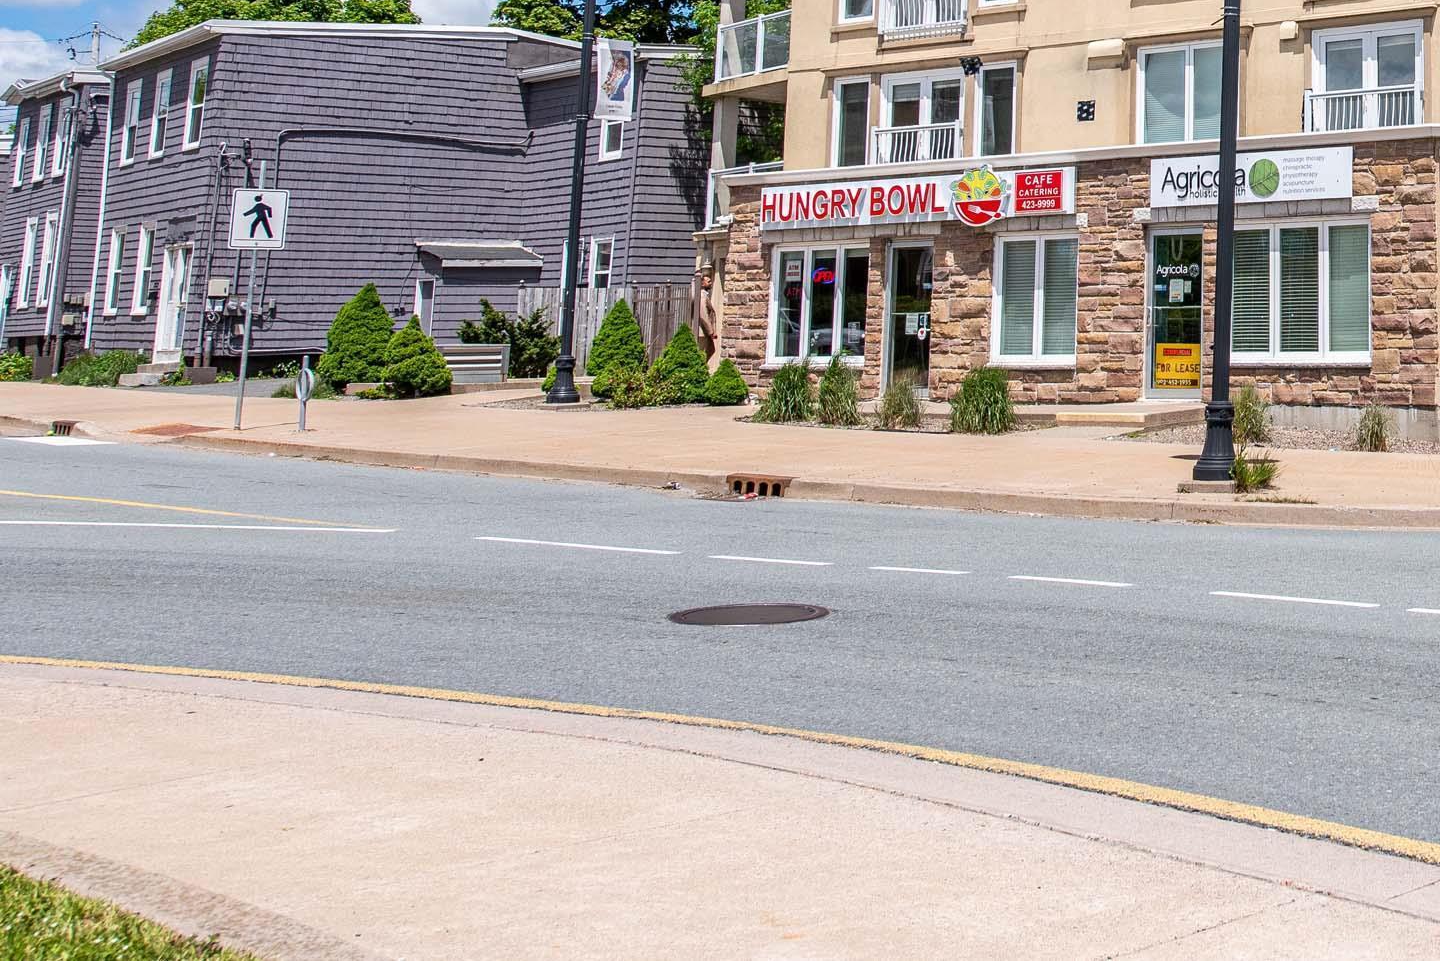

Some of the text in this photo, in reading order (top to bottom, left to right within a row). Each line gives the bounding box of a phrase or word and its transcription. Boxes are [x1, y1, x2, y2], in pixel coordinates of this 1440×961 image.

[1025, 174, 1053, 185] CAFE
[1018, 187, 1059, 197] CATERING
[1189, 189, 1218, 198] holistic
[762, 183, 945, 223] HUNGRY BOWL
[1022, 199, 1056, 209] 423-9999
[1156, 264, 1188, 278] Agricola
[1156, 363, 1200, 373] FOR LEASE
